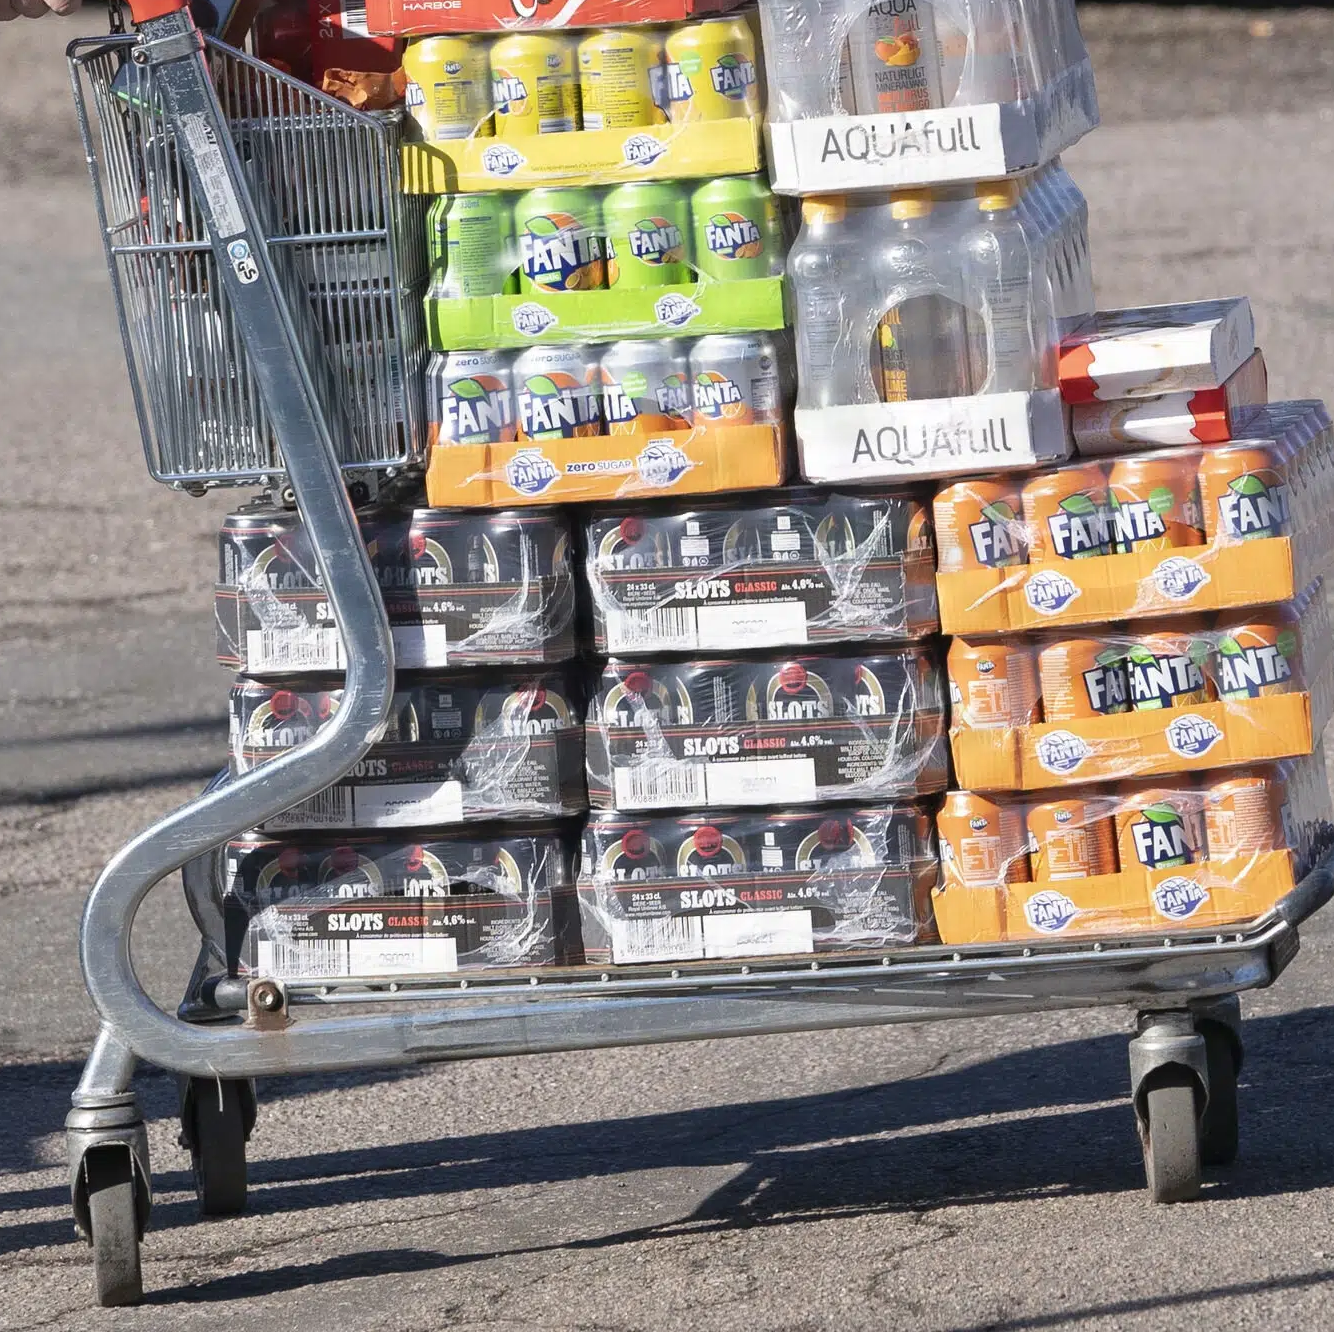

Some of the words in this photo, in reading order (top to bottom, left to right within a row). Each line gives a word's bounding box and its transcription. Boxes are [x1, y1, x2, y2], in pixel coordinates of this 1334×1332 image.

[402, 0, 463, 11] HARBOE
[492, 78, 528, 102] ANTA
[820, 116, 981, 166] AQUAfull
[482, 152, 523, 171] FANTA
[628, 228, 685, 253] FANTA
[704, 222, 761, 248] FANTA
[519, 232, 603, 275] FANTA
[513, 311, 553, 328] FANTA
[455, 357, 479, 368] zero
[692, 381, 743, 408] FANTA
[439, 390, 511, 437] FANT
[519, 390, 601, 441] FANTA
[851, 416, 1013, 467] AQUAfull
[509, 462, 556, 482] FANTA
[565, 463, 596, 473] zero
[597, 459, 632, 471] SUGAR
[970, 516, 1024, 562] FAN
[674, 579, 731, 600] SLOTS
[734, 580, 778, 593] CLASSIC
[791, 578, 815, 590] 4,6%
[1027, 580, 1075, 604] FANTA
[433, 601, 455, 614] 4,6%
[1217, 644, 1292, 692] ANTA
[768, 699, 831, 721] SLOTS
[1169, 721, 1221, 746] FANTA
[683, 735, 740, 757] SLOTS
[743, 737, 787, 750] CLASSIC
[1037, 738, 1089, 764] FANTA
[346, 759, 388, 778] LOTS
[404, 877, 448, 897] LOTS
[631, 893, 640, 901] 24
[645, 892, 654, 900] 33
[679, 887, 738, 909] SLOTS
[739, 889, 783, 902] CLASSIC
[1154, 883, 1207, 908] FANTA
[327, 913, 383, 932] SLOTS
[387, 916, 430, 928] CLASSIC
[442, 914, 466, 928] 4,6%
[1028, 901, 1077, 923] FANTA
